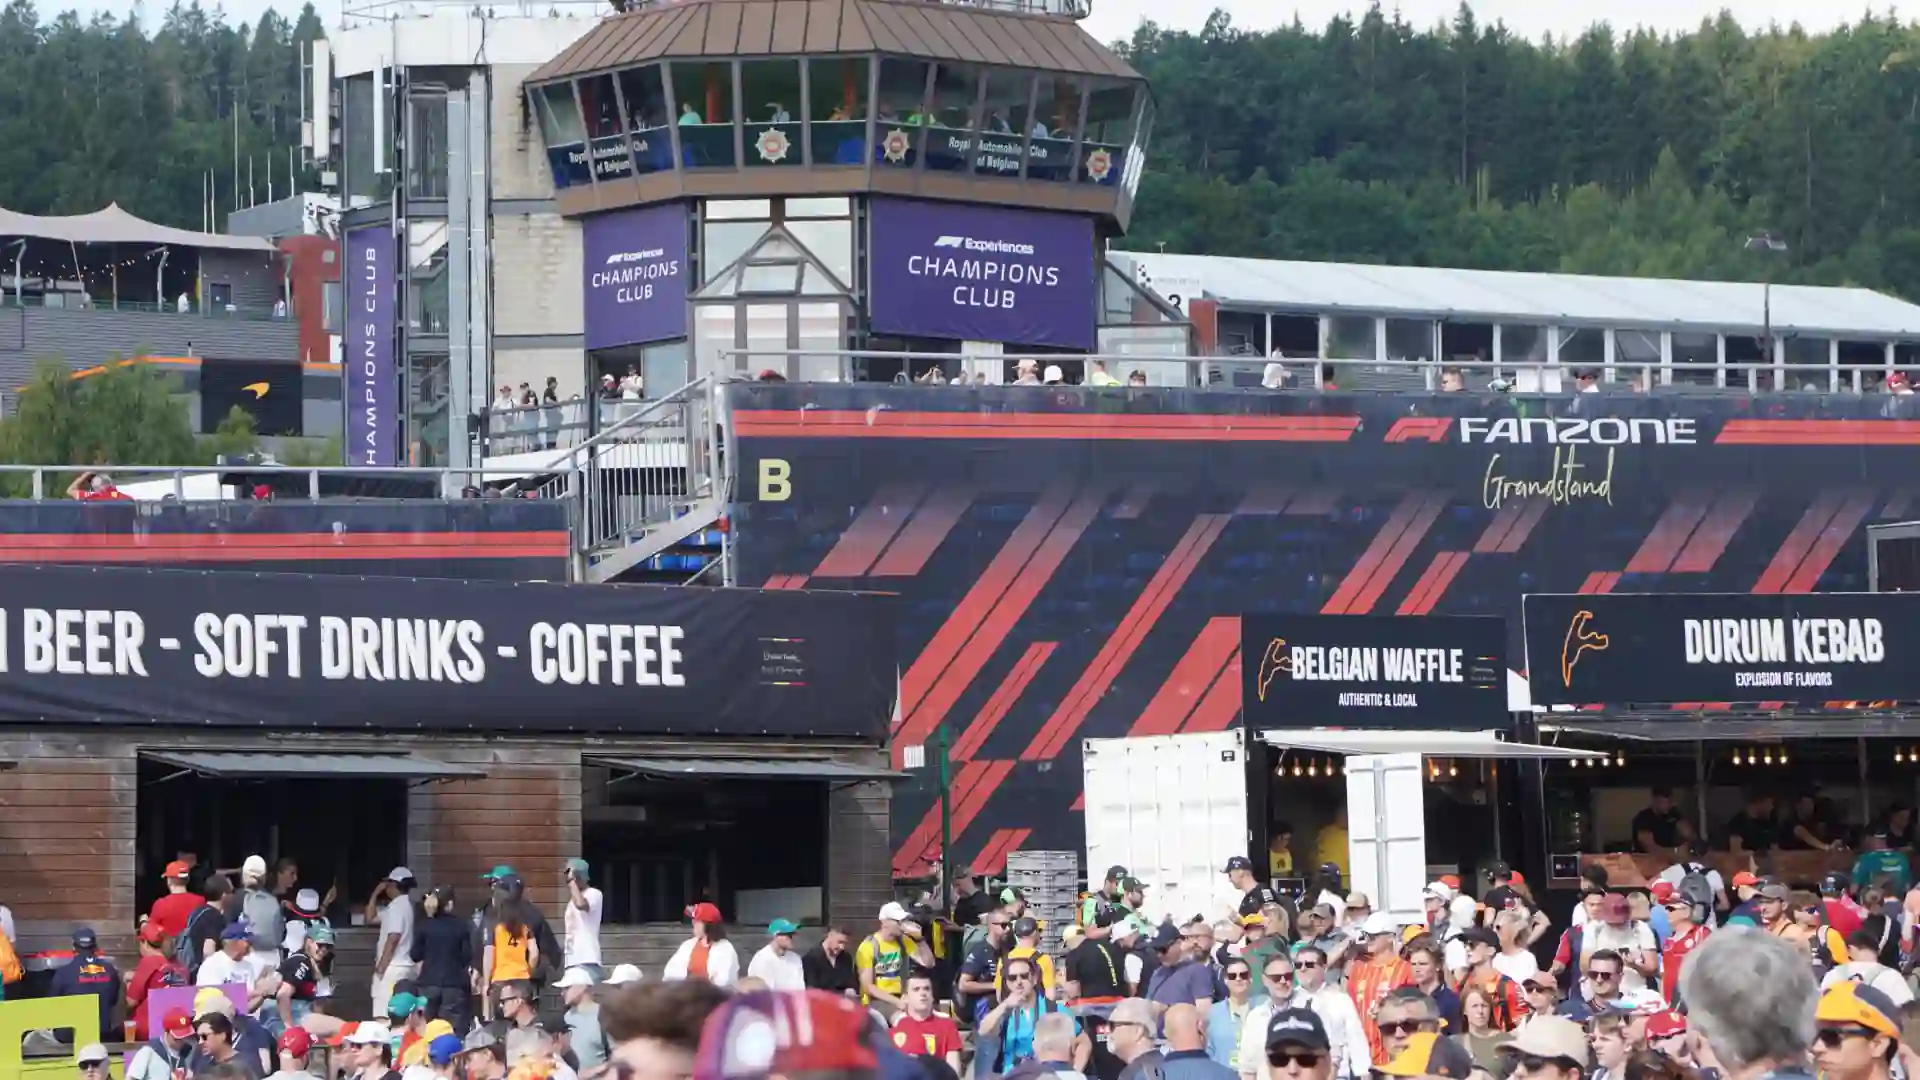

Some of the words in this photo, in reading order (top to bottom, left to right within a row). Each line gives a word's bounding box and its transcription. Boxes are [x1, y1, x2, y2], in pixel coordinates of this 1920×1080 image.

[949, 136, 970, 152] Royal
[978, 140, 1022, 155] Automobile
[1030, 145, 1048, 158] Club
[987, 156, 1019, 171] Belgium
[965, 238, 1034, 254] Experiences
[365, 248, 377, 312] CLUB
[592, 260, 678, 288] CHAMPIONS
[908, 255, 1059, 286] CHAMPIONS
[617, 284, 653, 303] CLUB
[953, 286, 1015, 308] CLUB
[365, 323, 377, 465] HAMPIONS
[1459, 417, 1697, 444] FANZONE
[759, 458, 792, 501] B
[1483, 444, 1614, 509] Grandstand
[24, 608, 149, 677] BEER
[194, 612, 308, 679] SOFT
[320, 615, 486, 684] DRINKS
[529, 621, 686, 687] COFFEE
[1684, 618, 1787, 664] DURUM
[1792, 618, 1885, 664] KEBAB
[1292, 646, 1378, 682] BELGIAN
[1383, 647, 1464, 683] WAFFLE
[1735, 672, 1781, 687] EXPLOSION
[1783, 672, 1794, 686] OF
[1795, 672, 1833, 687] FLAVORS
[1338, 692, 1382, 706] AUTHENTIC
[1384, 693, 1392, 706] &
[1393, 693, 1417, 707] LOCAL
